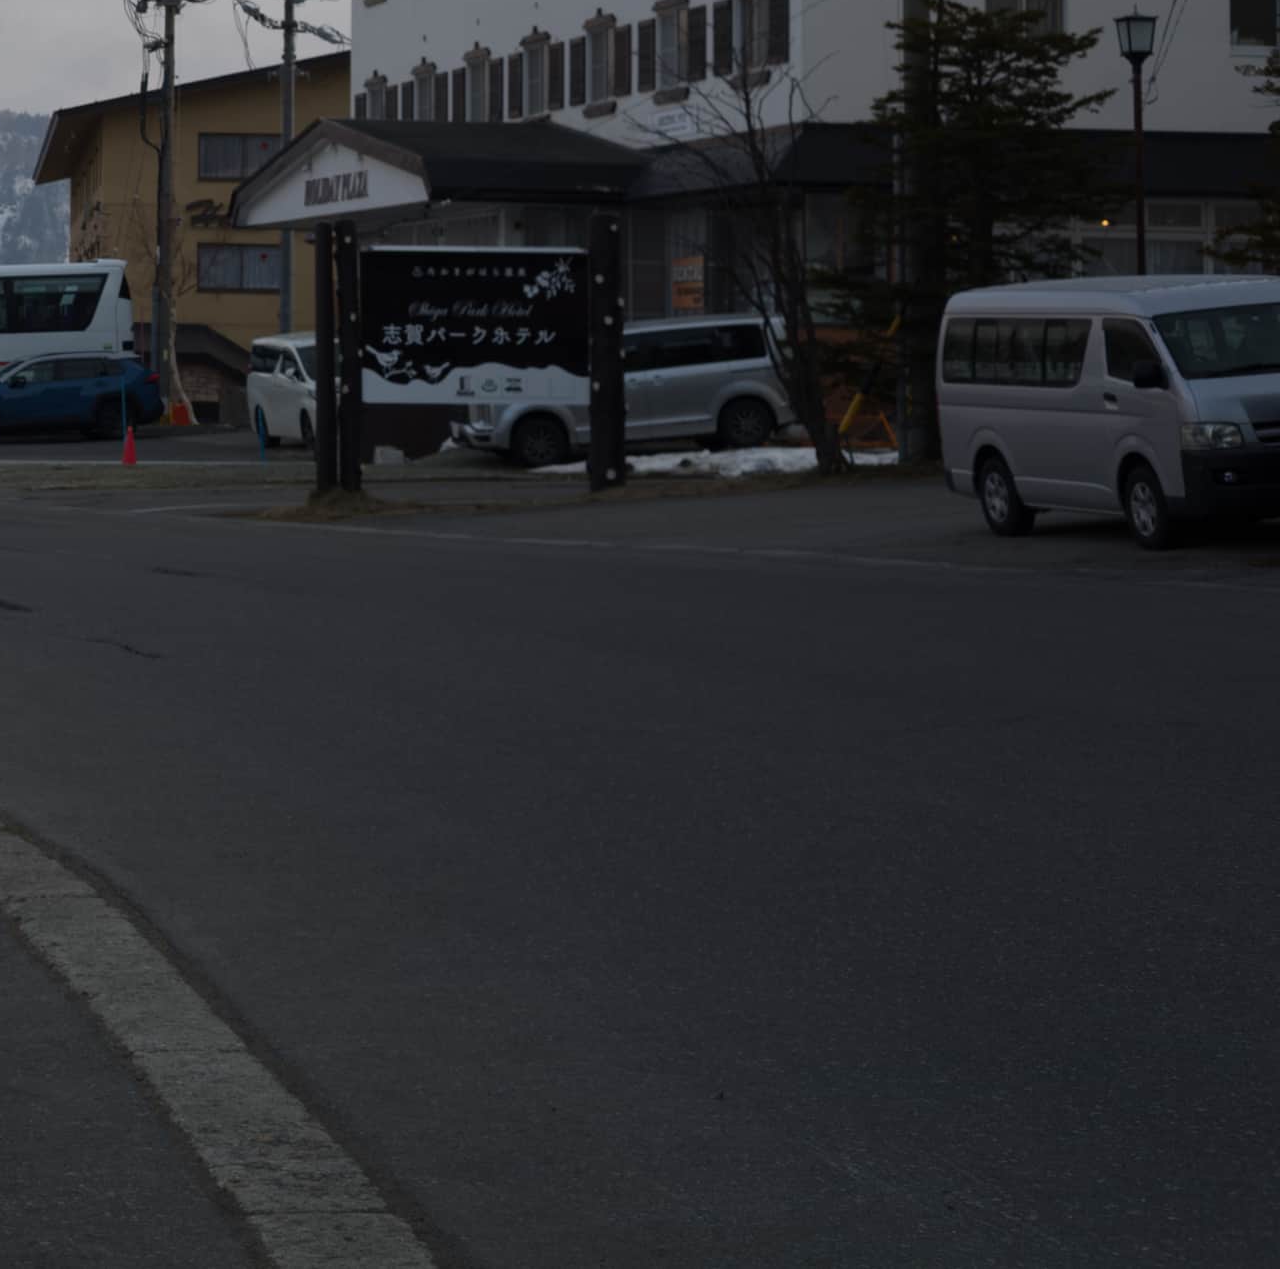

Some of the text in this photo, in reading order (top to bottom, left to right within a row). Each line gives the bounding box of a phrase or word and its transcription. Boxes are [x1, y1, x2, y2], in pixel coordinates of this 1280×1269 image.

[381, 323, 557, 346] 志賀パークホテル
